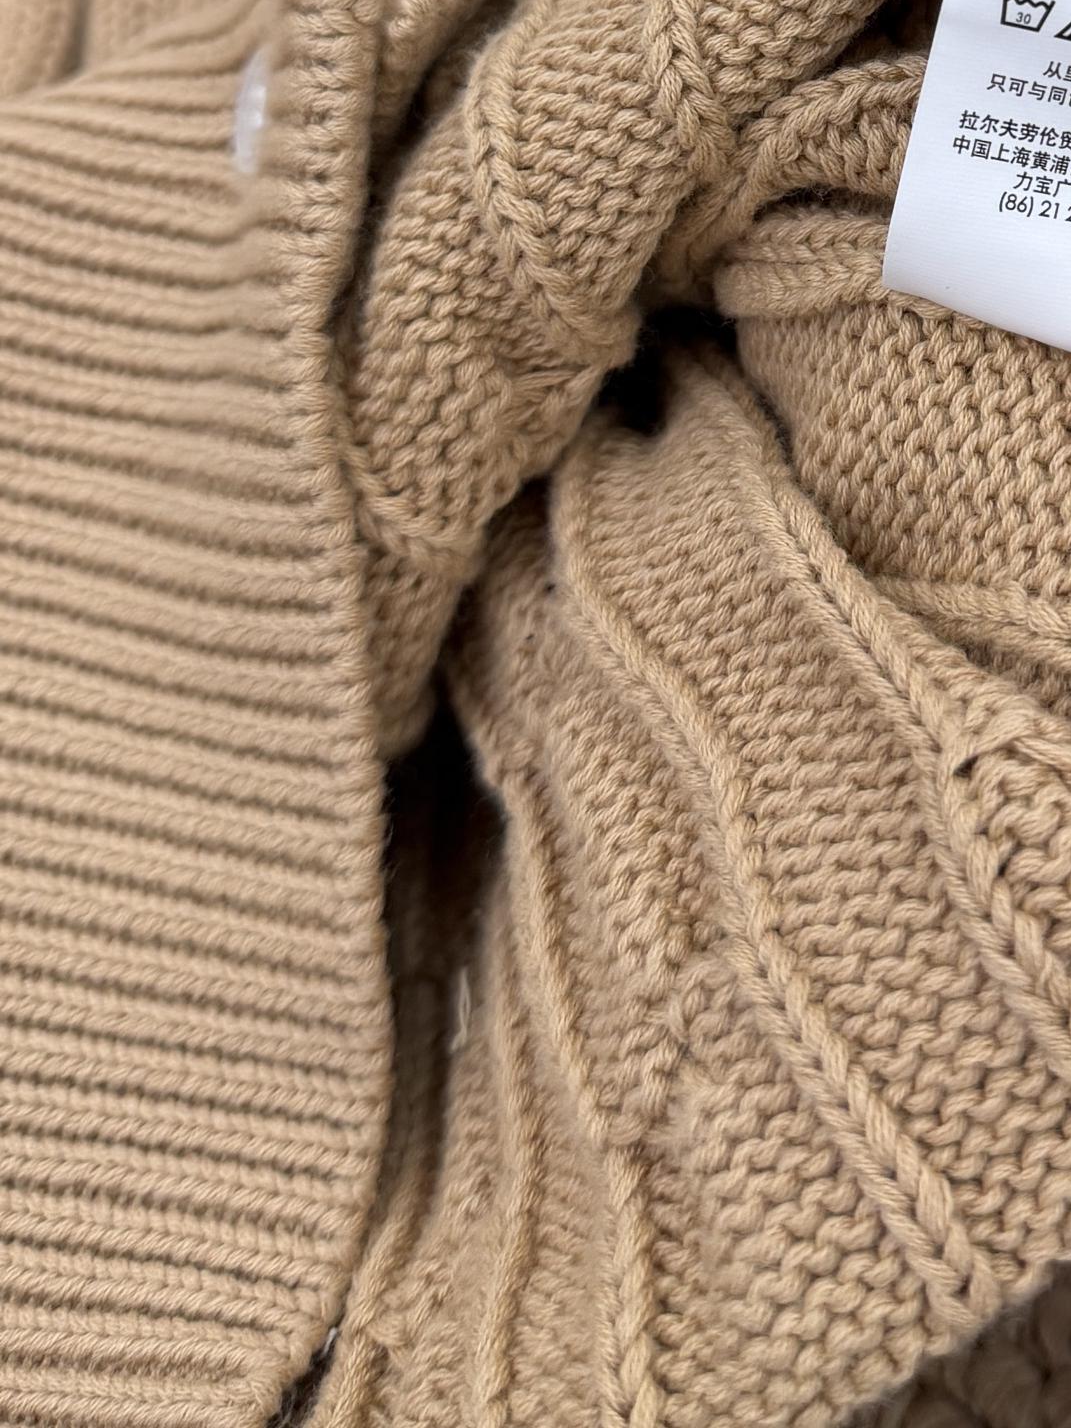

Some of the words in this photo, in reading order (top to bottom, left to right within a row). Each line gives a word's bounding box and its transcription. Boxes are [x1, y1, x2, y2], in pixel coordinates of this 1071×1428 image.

[1015, 11, 1032, 24] 30
[999, 191, 1034, 218] (86)
[1038, 199, 1060, 220] 21
